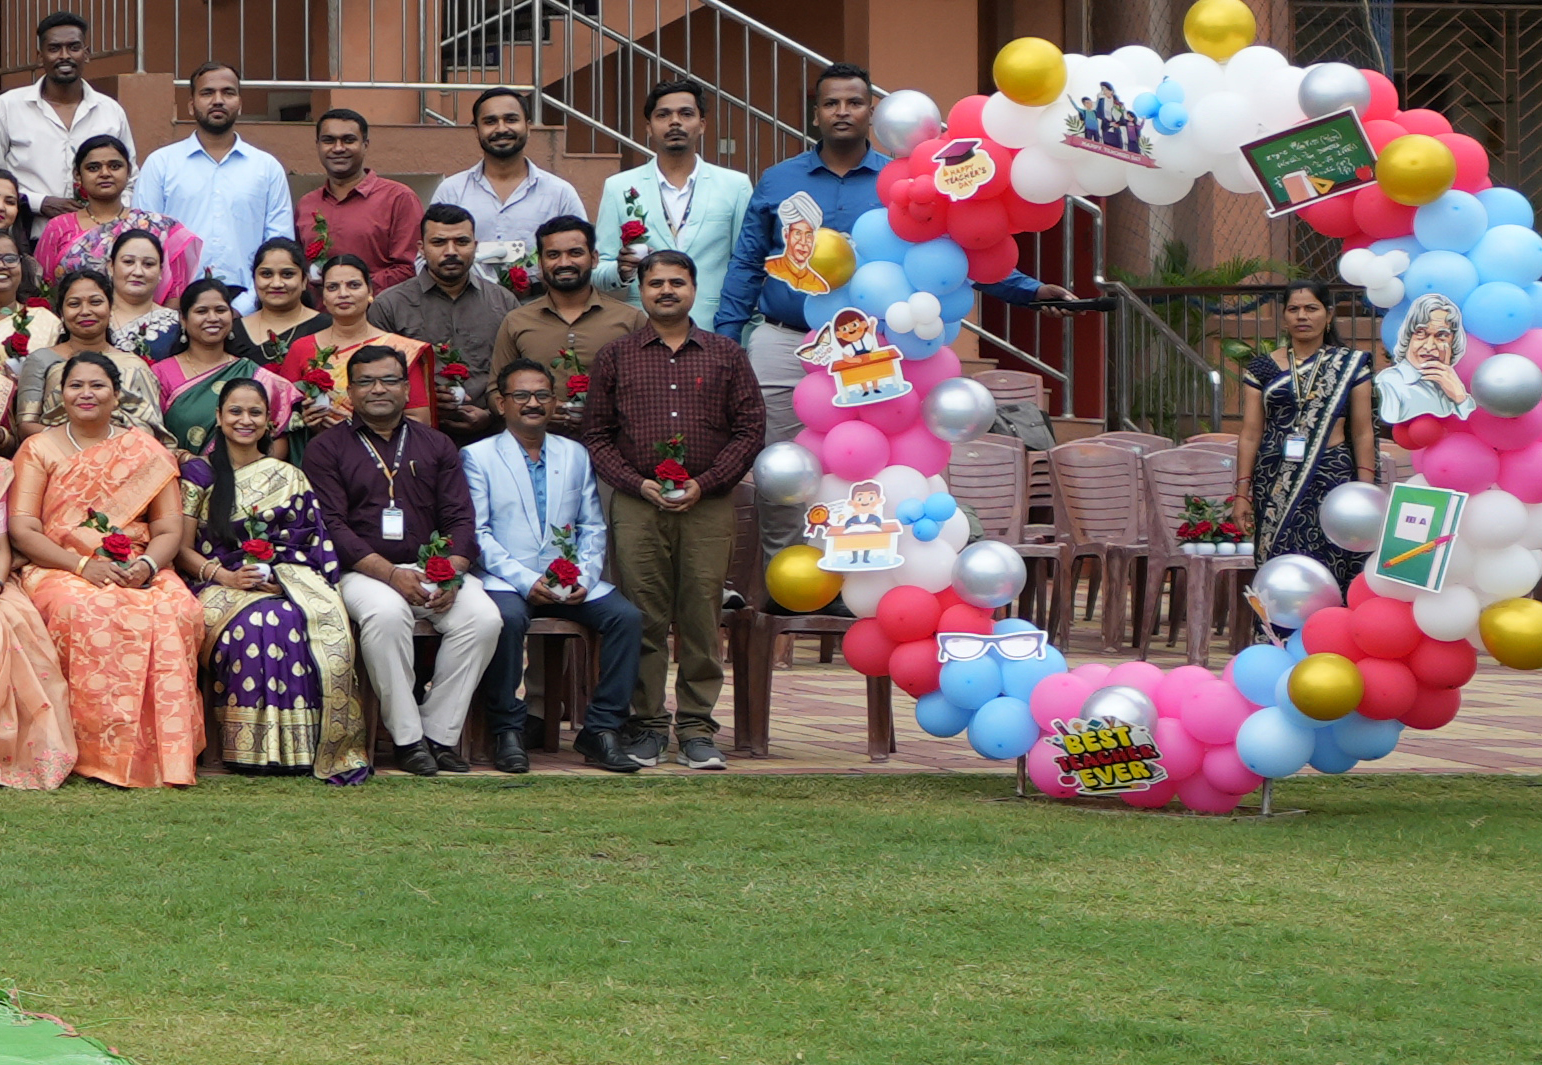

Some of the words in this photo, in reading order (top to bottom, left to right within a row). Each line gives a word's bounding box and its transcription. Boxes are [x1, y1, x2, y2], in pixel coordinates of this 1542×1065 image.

[950, 163, 974, 176] HAPPY
[958, 179, 973, 189] DAY
[1063, 725, 1132, 755] BEST
[1056, 744, 1158, 772] TEACHER
[1078, 760, 1152, 788] EVER
